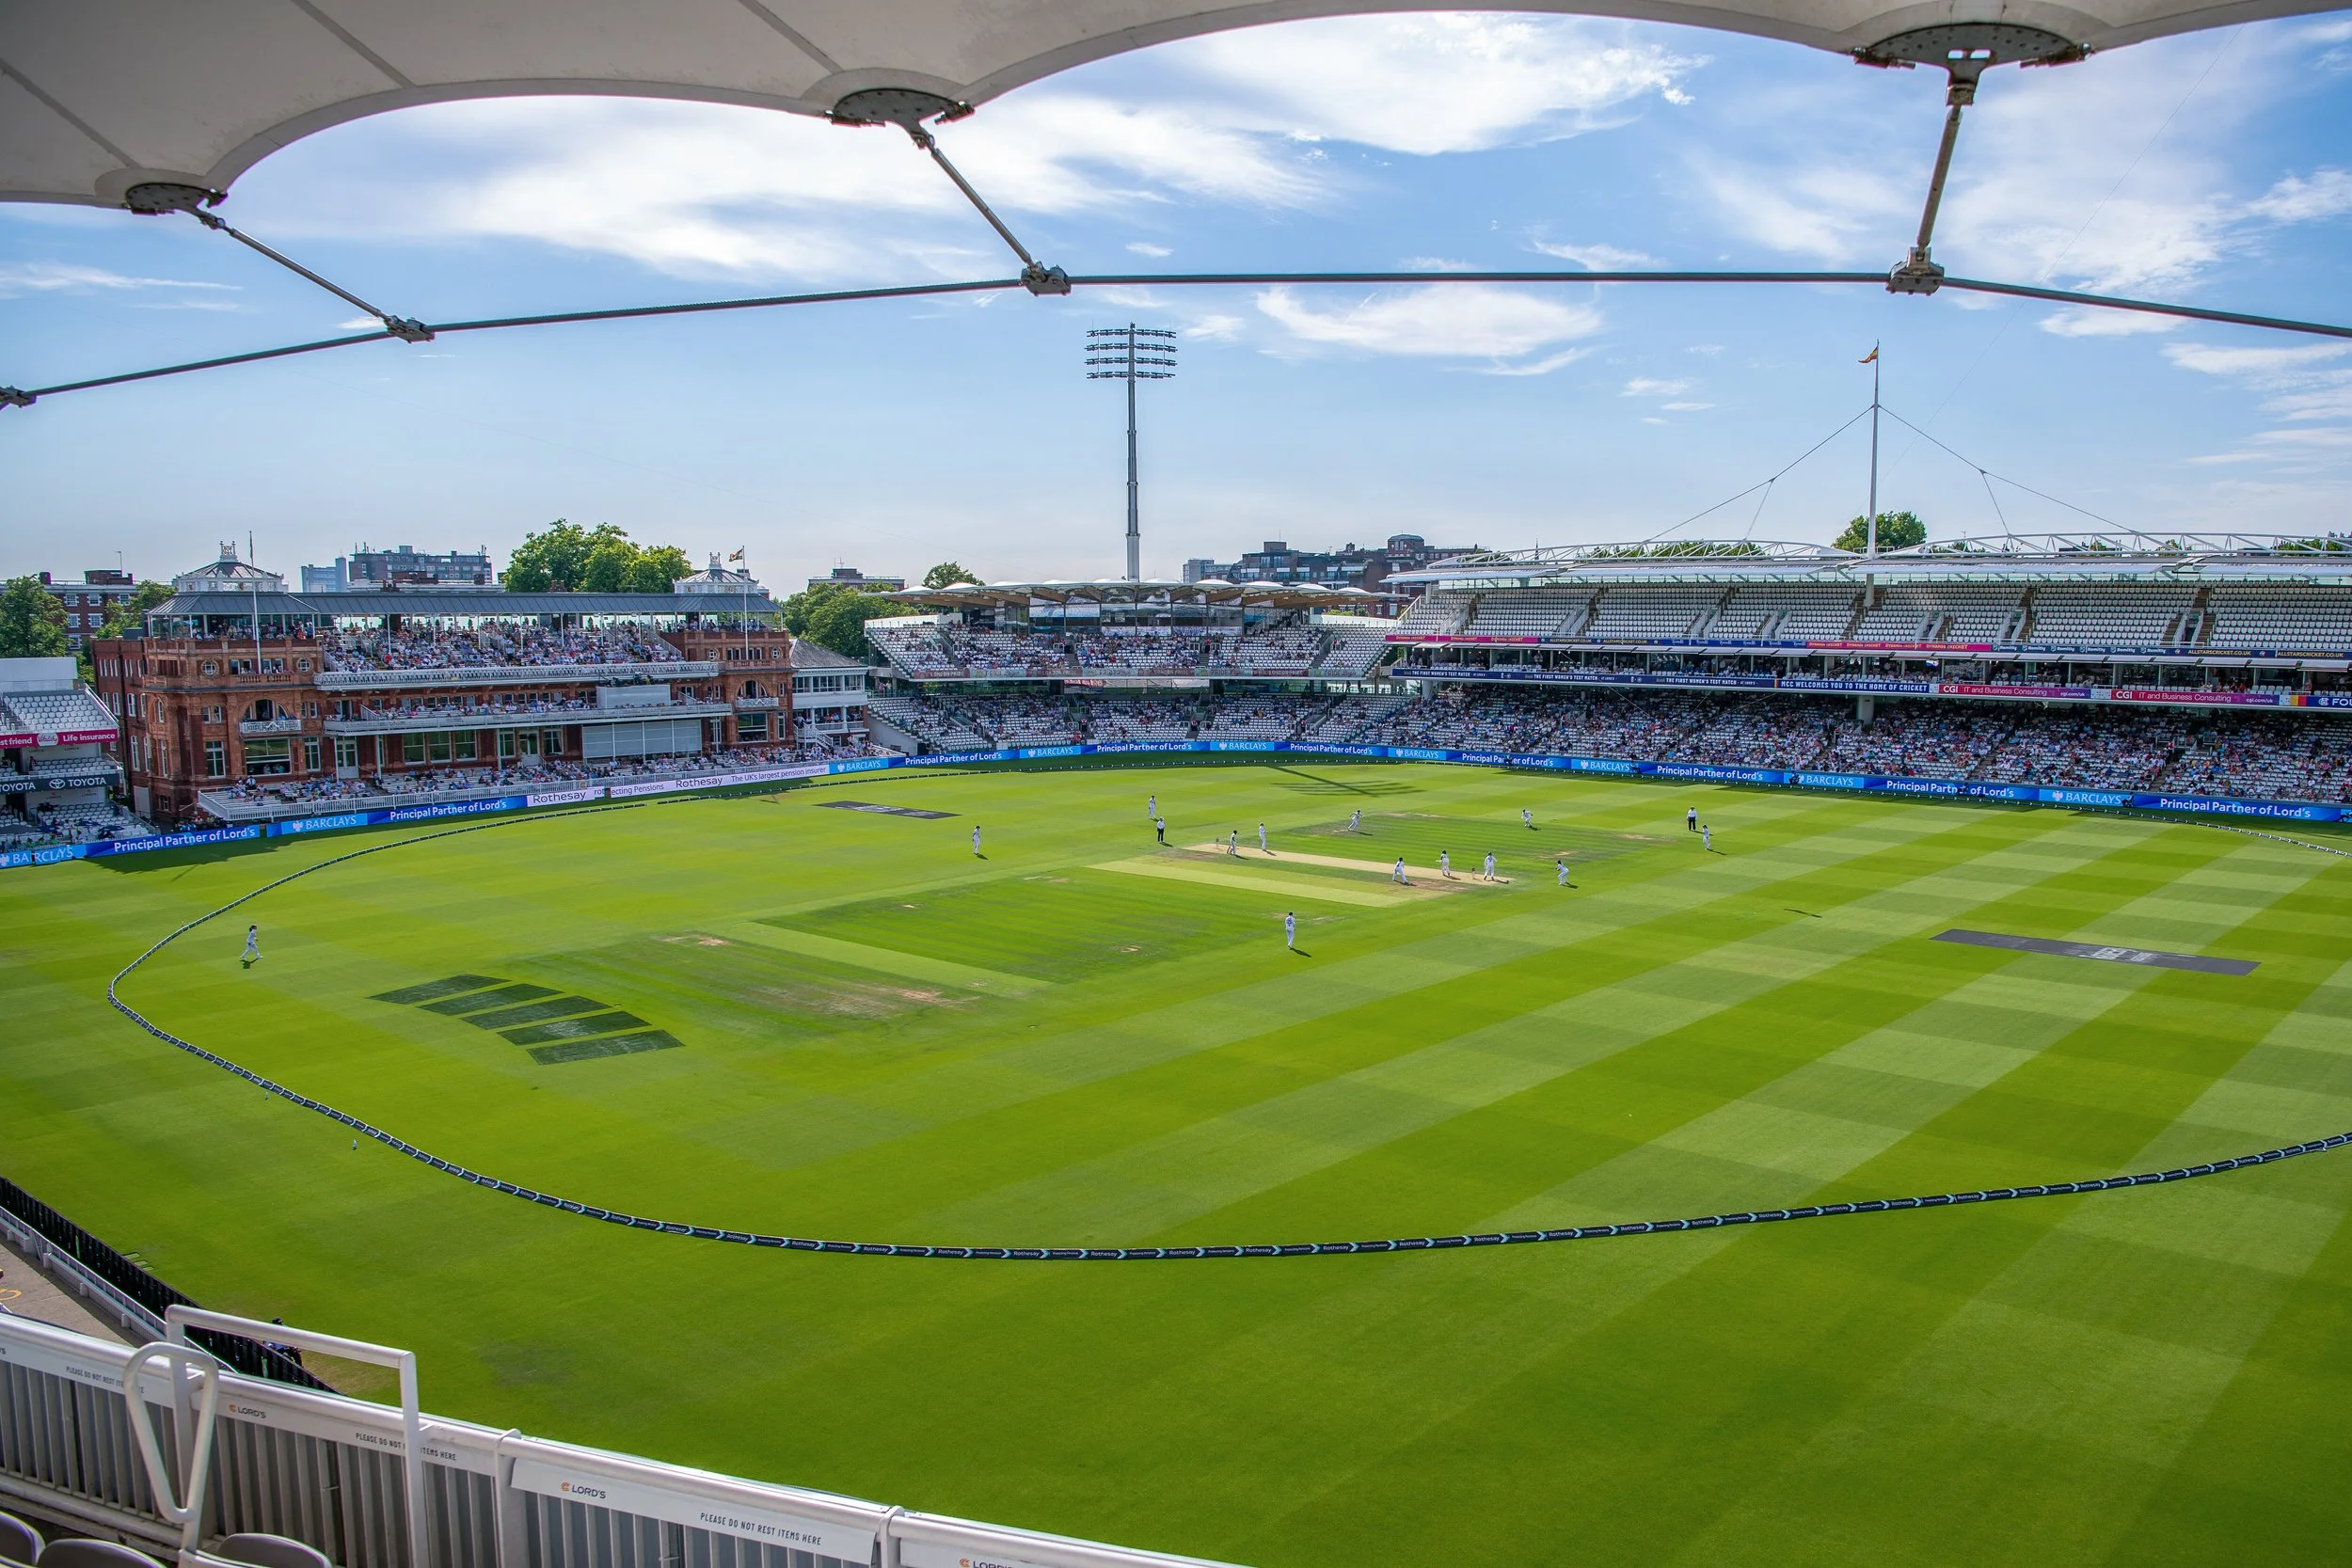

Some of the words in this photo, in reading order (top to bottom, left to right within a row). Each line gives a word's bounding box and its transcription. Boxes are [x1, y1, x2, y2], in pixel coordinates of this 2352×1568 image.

[1943, 685, 1958, 693] CGI
[1984, 687, 2012, 695] Business
[2013, 688, 2047, 697] Consulting
[2162, 692, 2193, 701] Business
[2194, 693, 2232, 704] Consulting
[9, 736, 33, 745] friend
[62, 734, 78, 742] Life
[79, 733, 116, 741] insurance
[1038, 747, 1073, 756] BARCLAYS
[1097, 743, 1128, 752] Principal
[1168, 742, 1192, 751] Lord's
[1290, 743, 1318, 753] Principal
[1319, 744, 1343, 753] Partner
[1344, 745, 1353, 753] of
[1353, 745, 1373, 754] Lord's
[905, 755, 939, 766] Principal
[939, 753, 968, 763] Partner
[969, 752, 978, 761] of
[978, 752, 1002, 760] Lord's
[1405, 749, 1439, 759] BARCLAYS
[1462, 752, 1492, 764] Principal
[1531, 757, 1553, 767] Lord's
[846, 759, 882, 770] BARCLAYS
[1590, 761, 1630, 771] BARCLAYS
[732, 774, 743, 783] The
[744, 773, 757, 783] UK's
[758, 771, 780, 782] largest
[781, 768, 803, 780] pension
[805, 766, 826, 776] insurer
[1657, 765, 1692, 778] Principal
[1693, 767, 1724, 779] Partner
[1726, 769, 1736, 779] of
[1737, 769, 1763, 781] Lord's
[68, 777, 107, 787] TOYOTA
[675, 776, 723, 789] Rothesay
[1805, 775, 1854, 786] BARCLAYS
[634, 783, 664, 795] Pensions
[1886, 780, 1929, 794] Principal
[1931, 783, 1968, 794] Partn
[1971, 785, 1982, 796] of
[1982, 786, 2014, 798] Lord's
[532, 791, 587, 805] Rothesay
[2065, 792, 2122, 805] BARCLAYS
[389, 807, 431, 821] Principal
[432, 804, 467, 817] Partner
[469, 800, 479, 812] of
[479, 799, 507, 811] Lord's
[2160, 798, 2210, 812] Principal
[2212, 802, 2257, 815] Partner
[2259, 804, 2273, 816] of
[2273, 806, 2311, 818] Lord's
[305, 816, 357, 830] BARCLAYS
[114, 836, 164, 852] Principal
[165, 832, 206, 848] Partner
[209, 829, 222, 842] of
[222, 827, 255, 839] Lord's
[13, 847, 73, 864] BARCLAYS
[1620, 1224, 1645, 1232] Rothesay
[791, 1240, 816, 1248] Rothesay
[66, 1365, 84, 1377] PLEASE
[84, 1370, 91, 1379] DO
[92, 1373, 103, 1382] NOT
[103, 1376, 115, 1385] REST
[237, 1406, 266, 1418] LORD'S
[355, 1432, 377, 1444] PLEASE
[378, 1437, 388, 1446] DO
[389, 1440, 401, 1449] NOT
[421, 1447, 438, 1457] ITEMS
[439, 1451, 457, 1461] HERE
[571, 1484, 607, 1498] LORD'S
[700, 1512, 726, 1526] PLEASE
[728, 1518, 739, 1528] DO
[740, 1521, 755, 1531] NOT
[757, 1524, 775, 1536] REST
[777, 1528, 800, 1541] ITEMS
[802, 1533, 821, 1545] HERE
